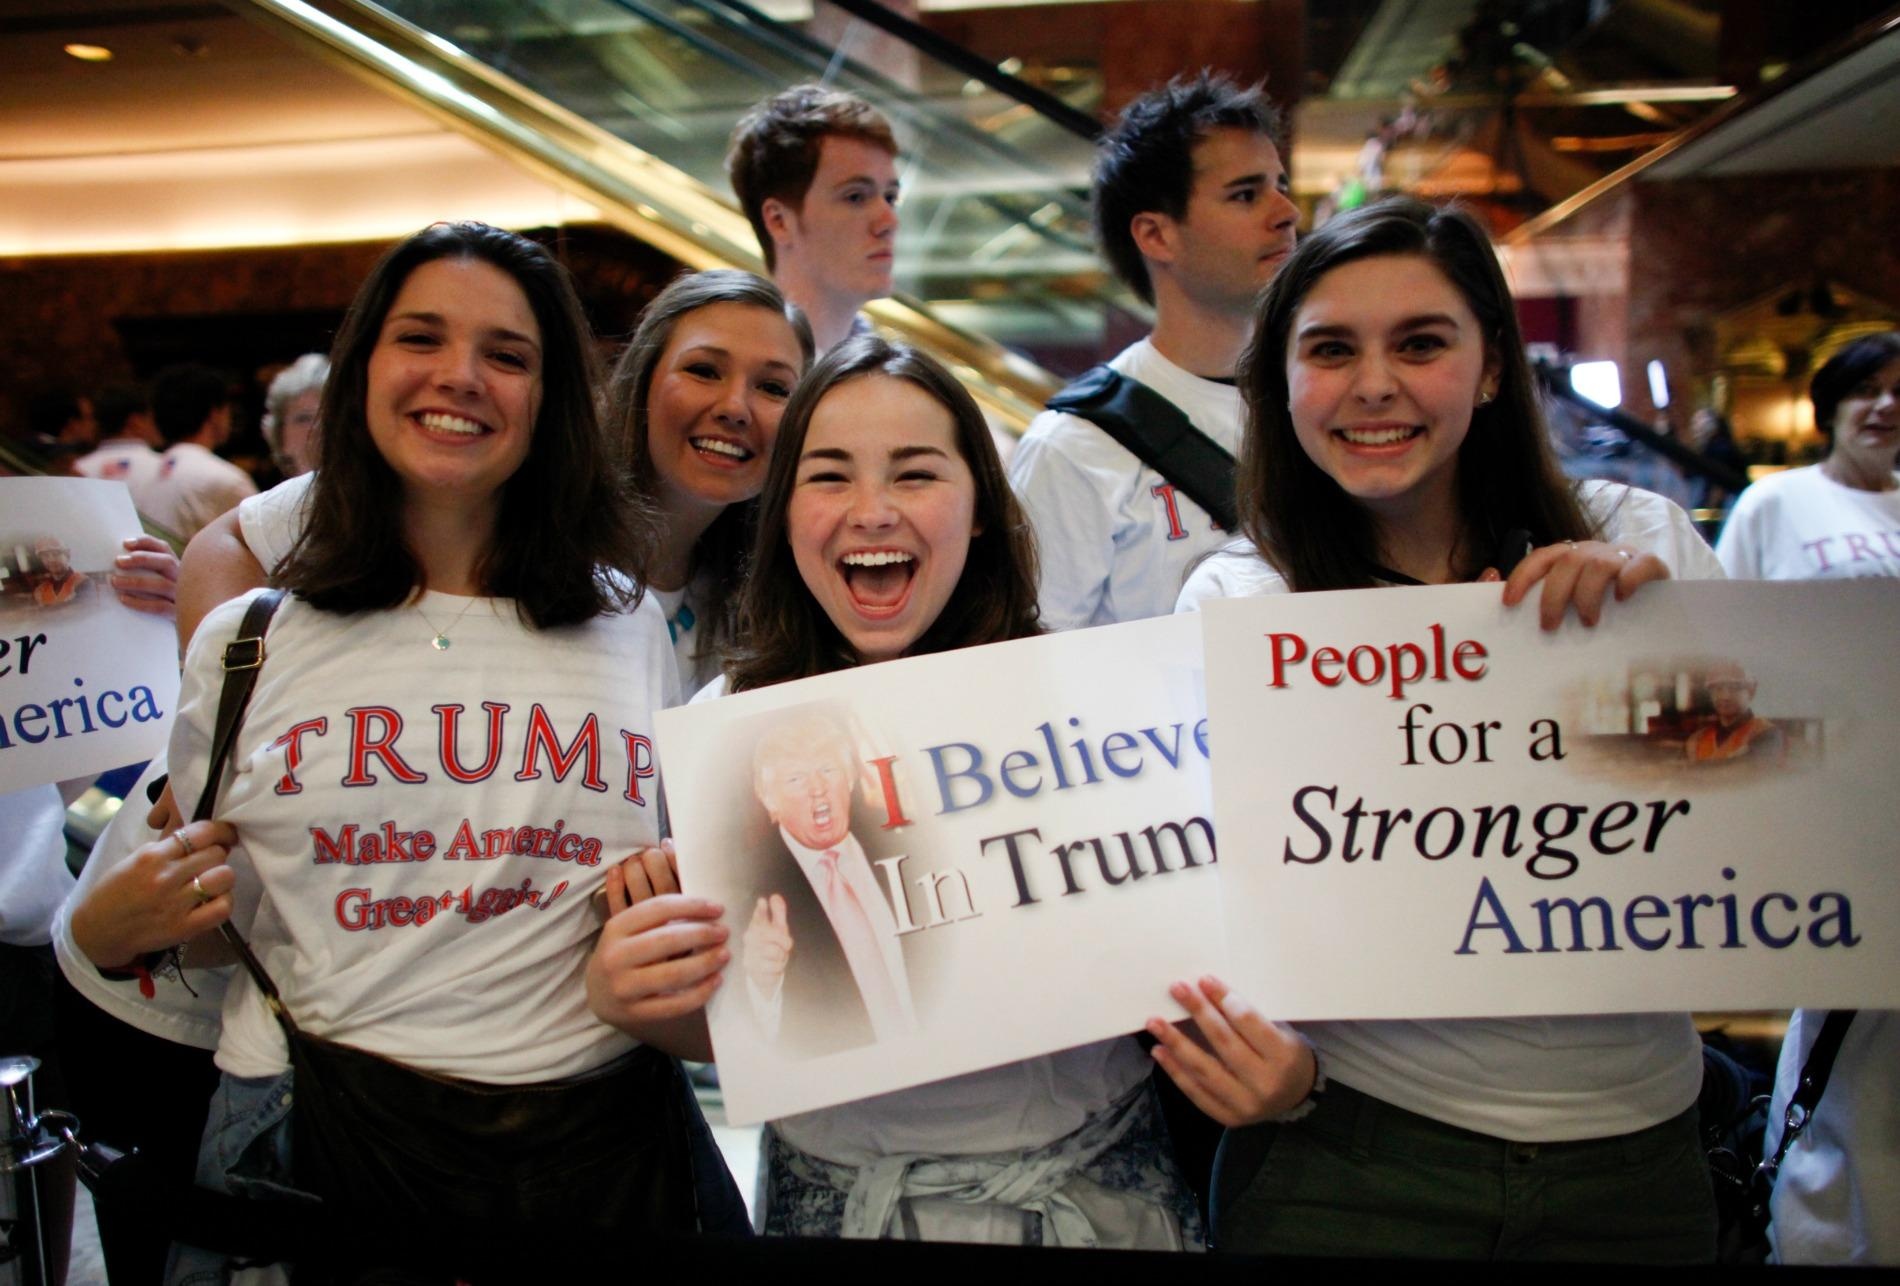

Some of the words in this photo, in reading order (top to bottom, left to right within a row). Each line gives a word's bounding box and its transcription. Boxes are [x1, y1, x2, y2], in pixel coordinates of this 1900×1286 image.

[1264, 624, 1489, 700] People
[0, 677, 163, 750] erica
[1397, 703, 1502, 766] for
[1528, 717, 1568, 761] a
[266, 701, 654, 807] TRUMP
[867, 755, 914, 831] I
[309, 820, 437, 866] Make
[443, 818, 603, 867] America
[1283, 784, 1692, 880] Stronger
[874, 853, 984, 937] In
[1453, 867, 1862, 955] America
